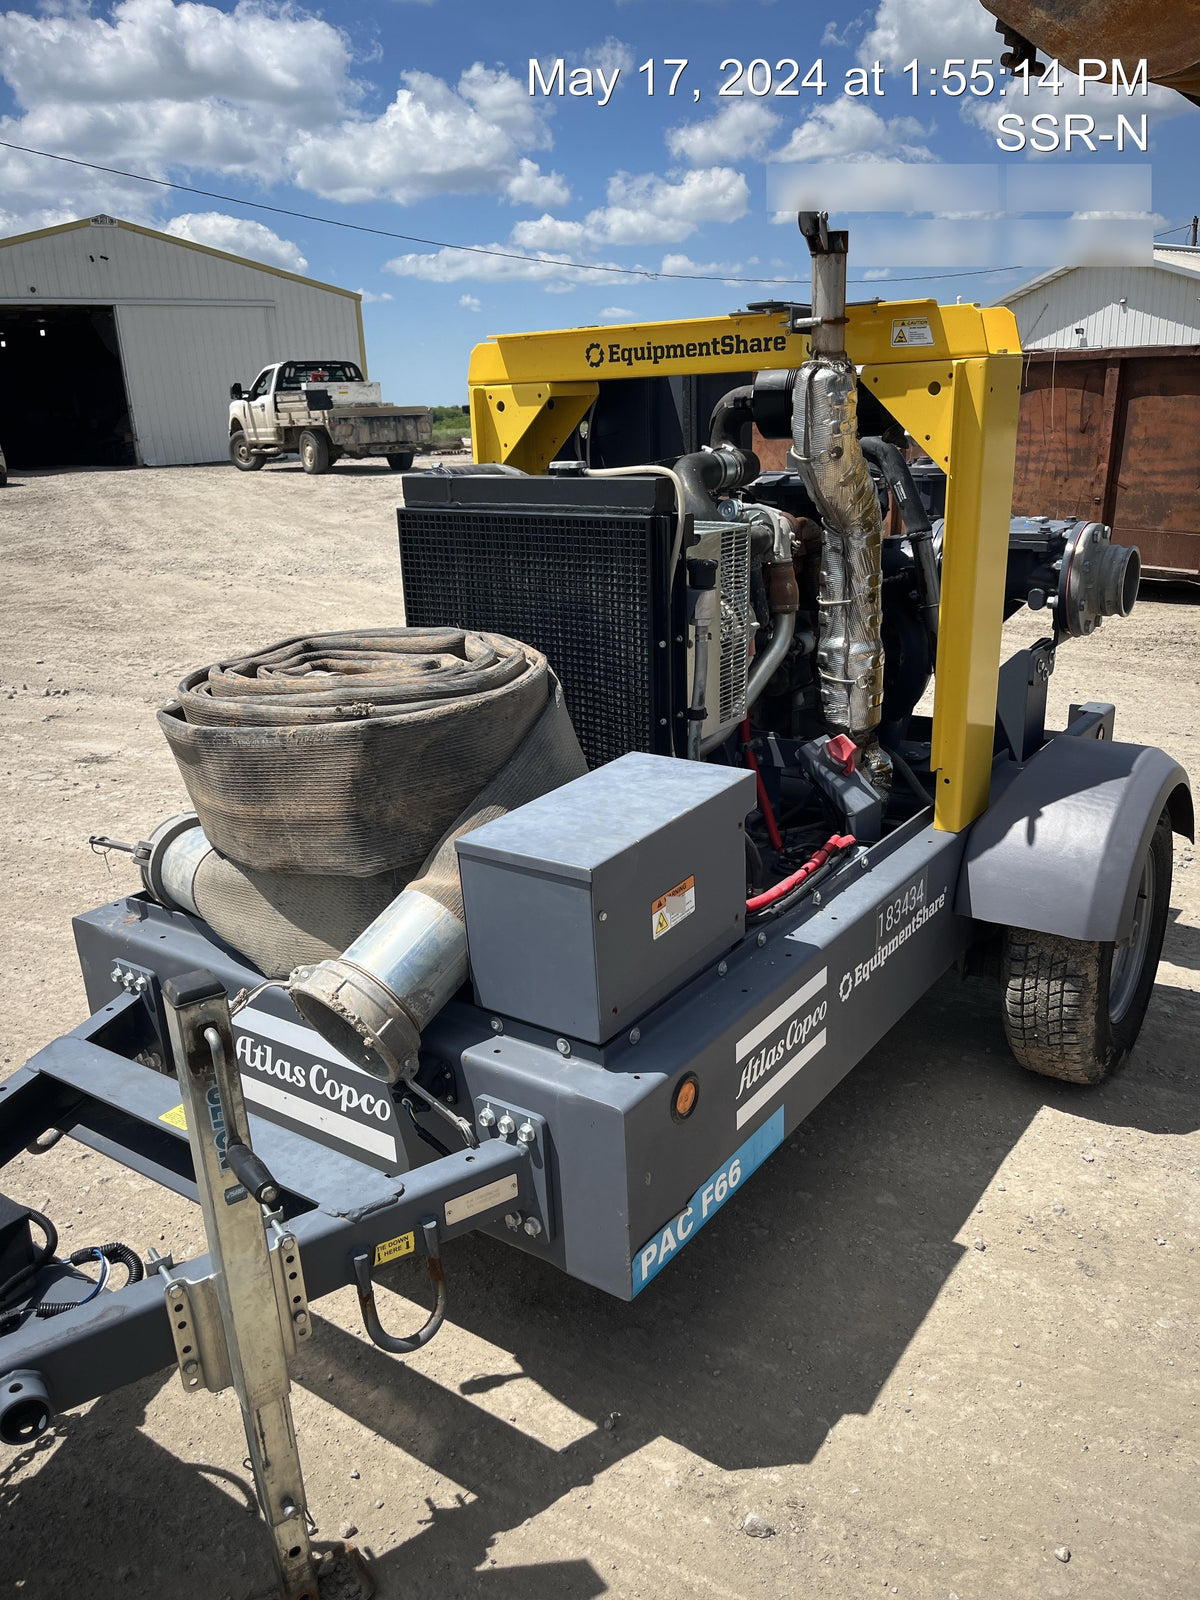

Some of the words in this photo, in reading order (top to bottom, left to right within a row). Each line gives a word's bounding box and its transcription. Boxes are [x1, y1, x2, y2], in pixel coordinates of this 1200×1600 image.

[608, 334, 786, 366] EquipmentShare
[854, 893, 945, 987] EquipmentShare
[878, 879, 924, 937] 183434
[235, 1035, 306, 1087] Atlas
[309, 1064, 391, 1121] Copco
[736, 1039, 785, 1100] Atlas
[786, 1000, 828, 1050] Copco
[377, 1243, 387, 1252] TIE
[388, 1235, 409, 1248] DOWN
[384, 1245, 402, 1256] HERE
[641, 1207, 694, 1281] PAC
[702, 1159, 742, 1219] F66
